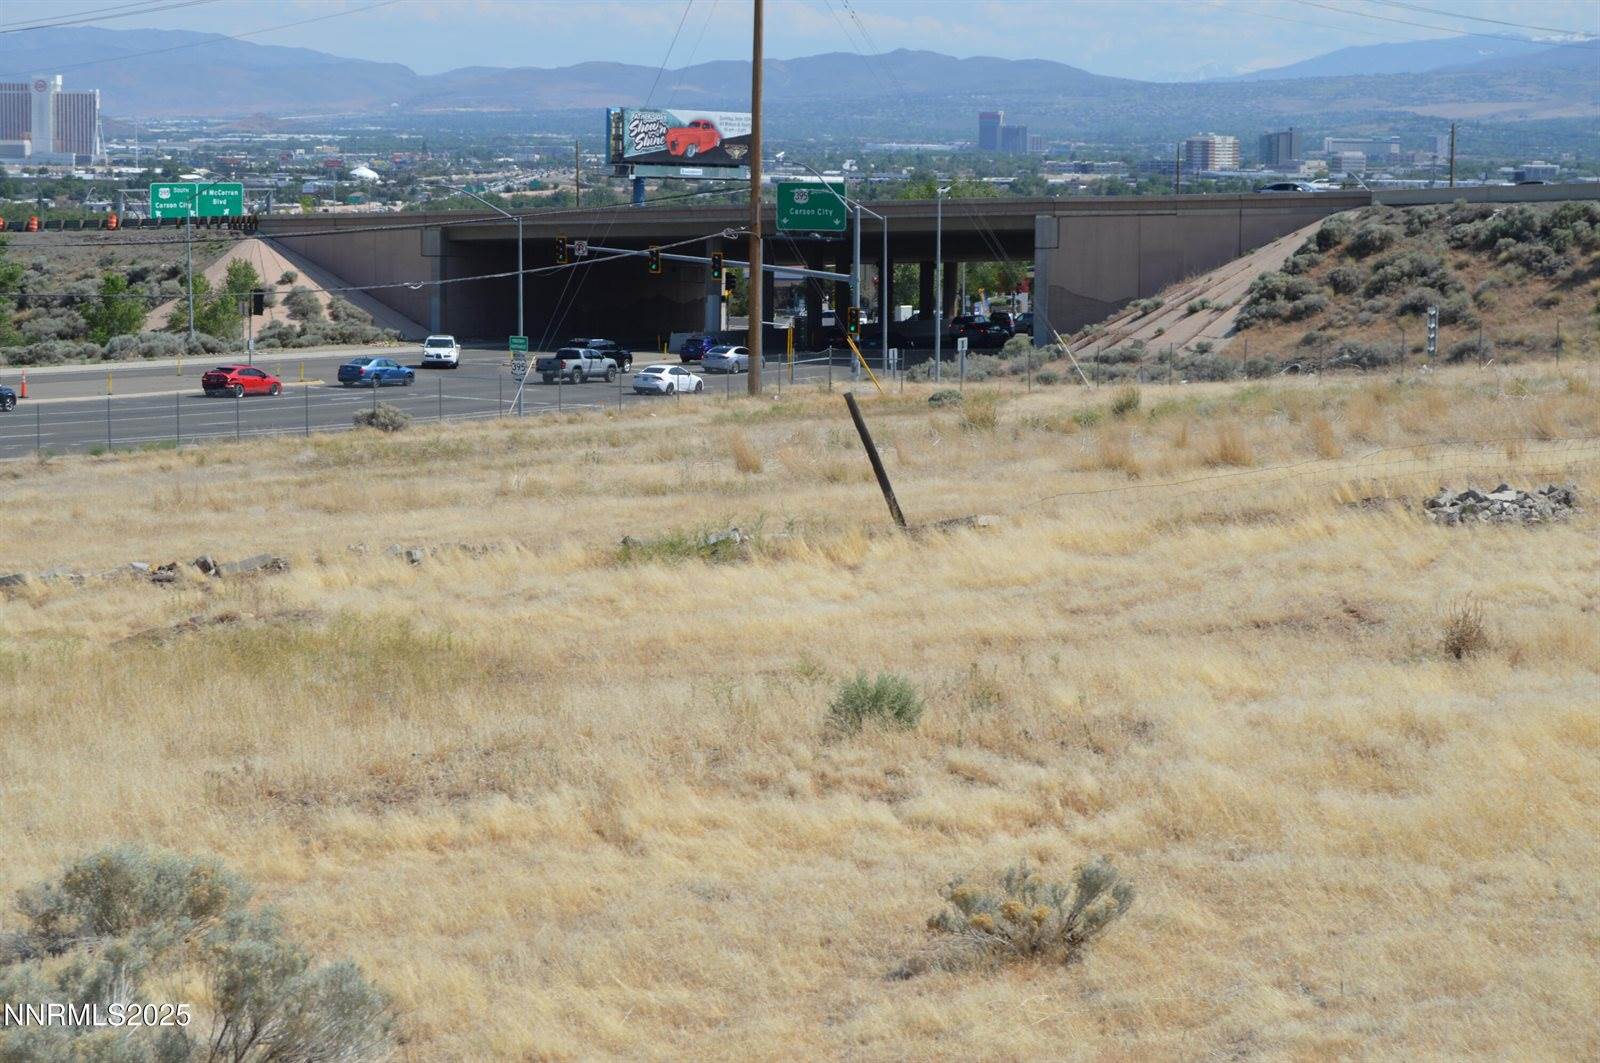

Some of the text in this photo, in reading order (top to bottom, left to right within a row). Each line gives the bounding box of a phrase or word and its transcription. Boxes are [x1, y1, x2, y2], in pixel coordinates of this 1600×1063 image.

[629, 119, 660, 137] Show
[634, 132, 666, 150] Shine
[794, 191, 808, 200] 395
[789, 207, 833, 216] Carson City
[512, 362, 526, 371] 395
